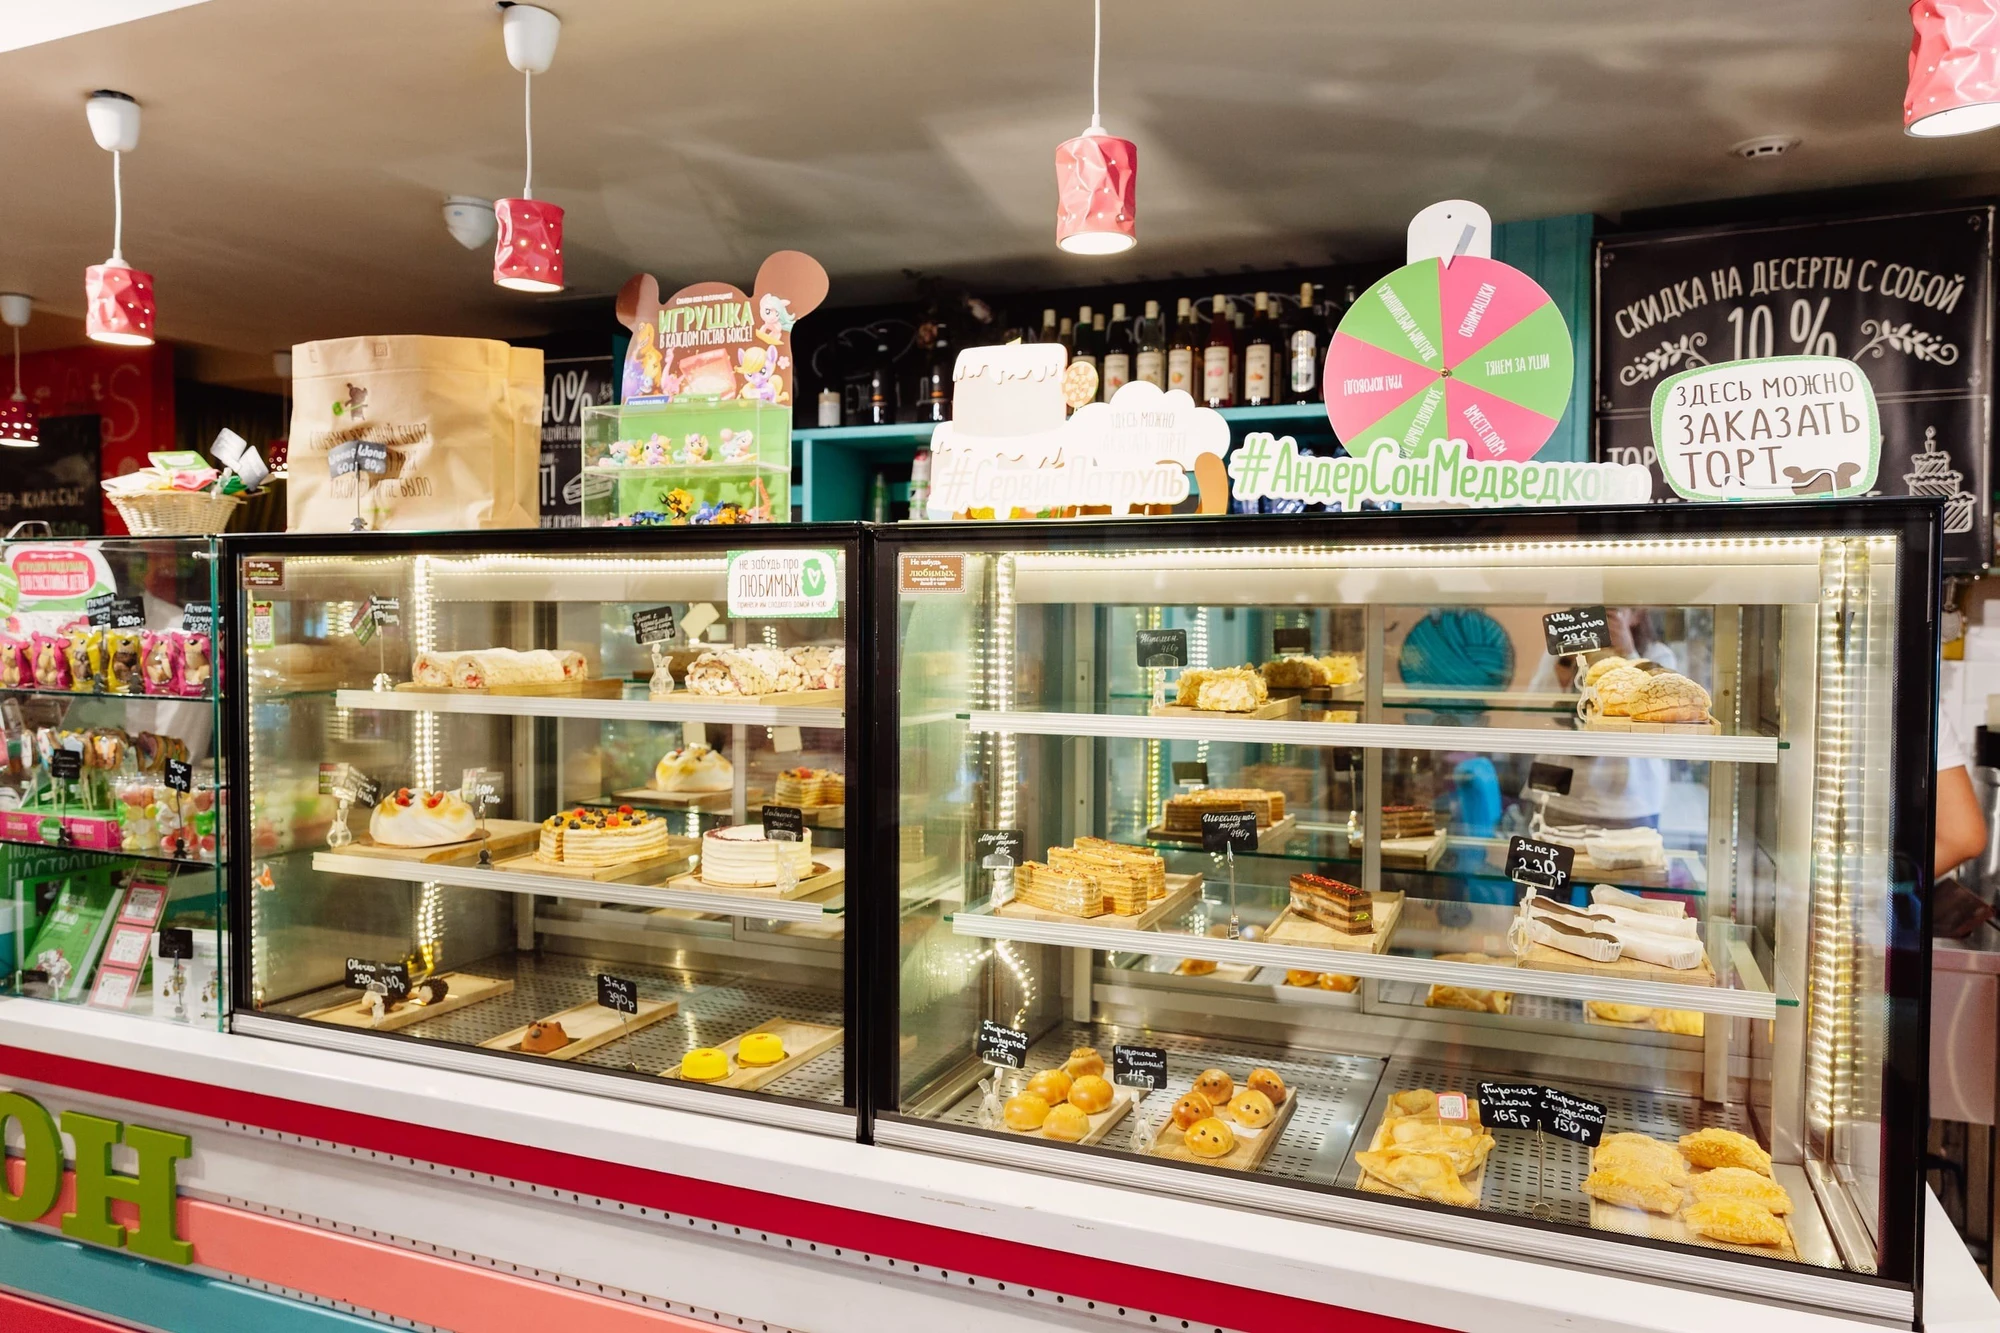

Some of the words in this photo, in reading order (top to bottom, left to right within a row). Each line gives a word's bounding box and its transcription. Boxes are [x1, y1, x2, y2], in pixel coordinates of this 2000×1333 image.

[1376, 282, 1417, 333] ИМЕНИННИКА
[1615, 276, 1708, 338] СКИДКА
[1711, 266, 1743, 301] НА
[1749, 256, 1854, 297] ДЕСЕРТЫ
[1857, 260, 1877, 293] С
[1880, 262, 1966, 315] СОБОЙ
[658, 301, 755, 333] ИГРУШКА
[1458, 282, 1497, 338] ОБНИМАШКИ
[659, 334, 664, 349] В
[665, 331, 699, 348] КАЖДОМ
[726, 325, 753, 343] БОКСЕ!
[1727, 304, 1774, 359] 10
[1407, 327, 1438, 363] ХВАЛИМ
[1485, 358, 1513, 377] ТЯНЕМ
[1514, 356, 1526, 372] ЗА
[1527, 353, 1551, 370] УШИ
[1344, 376, 1384, 396] ХОРОВОД!
[1385, 374, 1403, 392] УРА!
[1676, 380, 1752, 408] ЗДЕСЬ
[1763, 371, 1855, 398] МОЖНО
[1140, 411, 1175, 428] МОЖНО
[1403, 387, 1444, 447] ЗАЖИГАТЕЛЬНО
[1679, 402, 1861, 446] ЗАКАЗАТЬ
[1463, 403, 1494, 437] ВМЕСТЕ
[1482, 431, 1508, 457] ПОЁМ
[1679, 445, 1783, 489] ТОРТ
[739, 560, 749, 570] не
[751, 556, 781, 570] забудь
[783, 558, 799, 573] про
[909, 568, 957, 577] любимых,
[910, 558, 920, 566] Не
[920, 559, 942, 567] забудь
[738, 574, 800, 598] ЛЮБИМЫХ
[1518, 857, 1567, 886] 230р
[607, 990, 635, 1011] 390р
[1481, 1083, 1537, 1099] Пирожок
[1545, 1089, 1601, 1114] Пирожок
[1493, 1109, 1530, 1128] 165р
[1553, 1117, 1590, 1141] 150р
[0, 1091, 194, 1266] ОН
